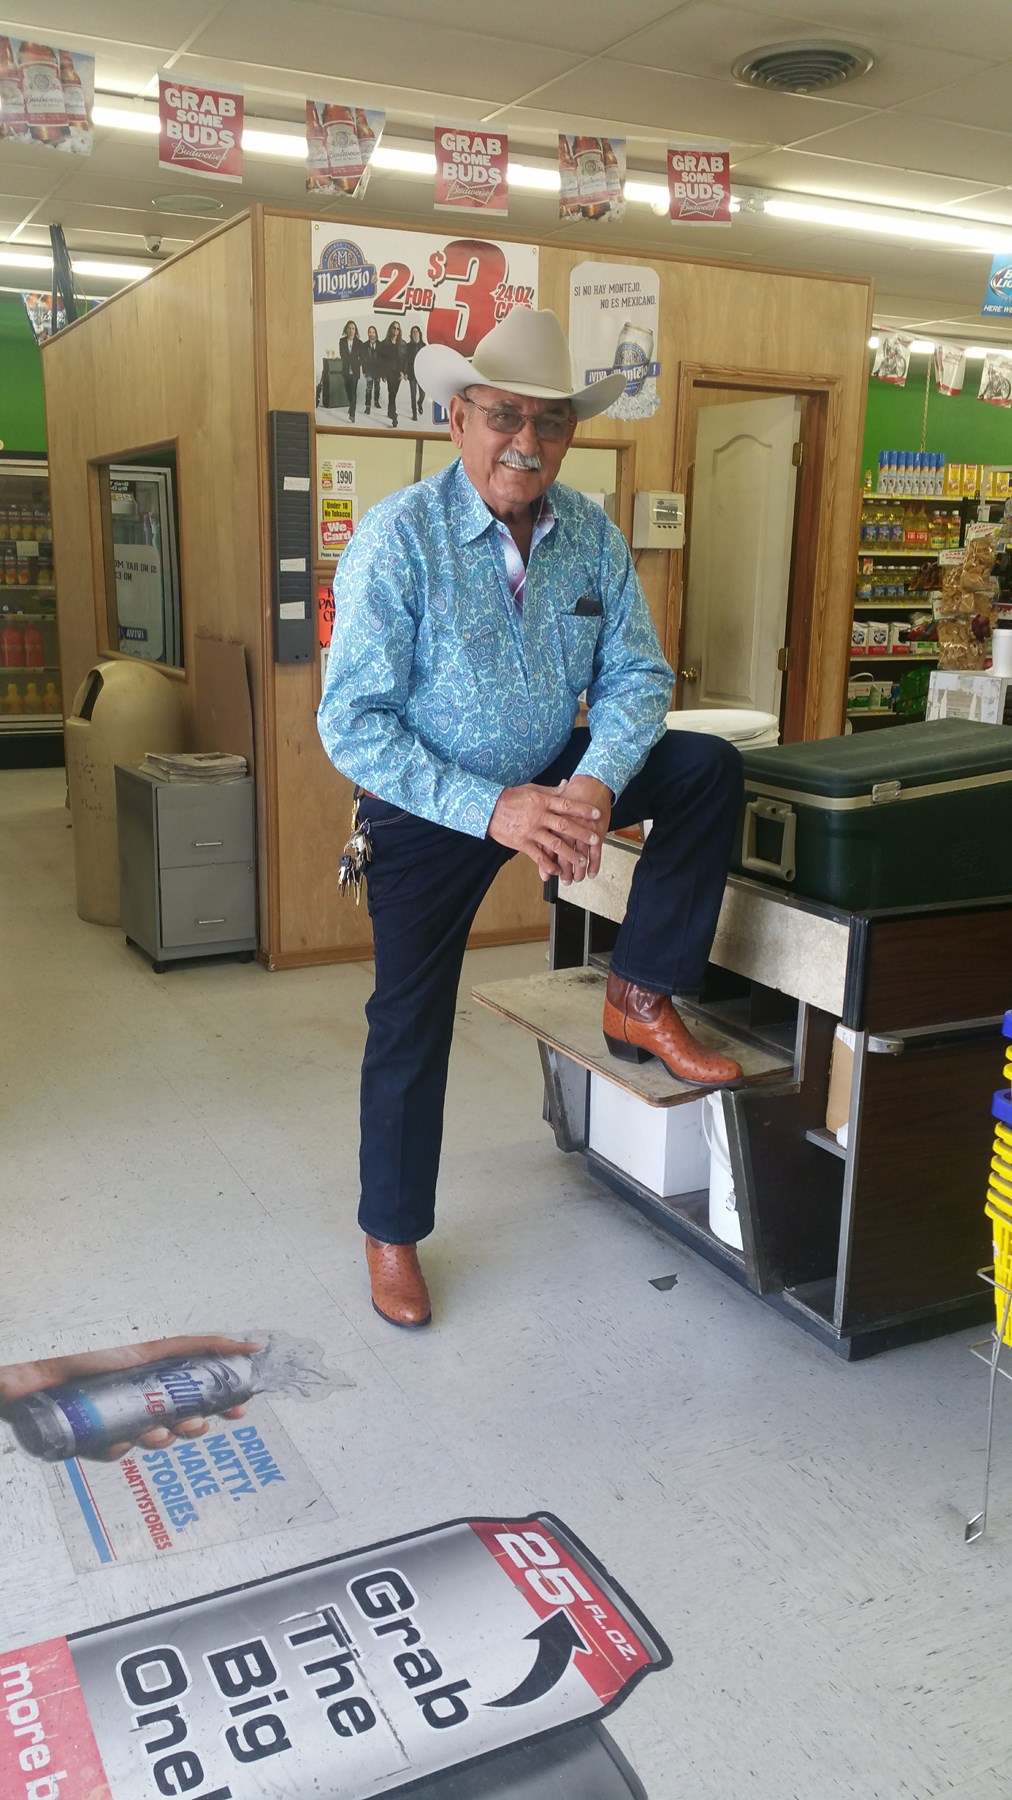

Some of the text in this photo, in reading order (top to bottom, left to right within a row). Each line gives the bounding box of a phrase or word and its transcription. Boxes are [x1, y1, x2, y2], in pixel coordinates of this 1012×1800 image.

[164, 87, 236, 117] GRAB
[176, 109, 223, 128] SOME
[166, 119, 235, 149] BUDS
[441, 132, 502, 155] GRAB
[173, 143, 226, 161] Budweiser
[452, 152, 491, 166] SOME
[672, 154, 724, 172] GRAB
[442, 162, 502, 185] BUDS
[681, 172, 715, 183] SOME
[449, 183, 495, 197] Budweiser
[674, 182, 725, 200] BUDS
[316, 268, 370, 295] Montejo
[373, 261, 412, 312] 2
[404, 287, 434, 308] FOR
[497, 283, 514, 301] 24
[574, 286, 581, 297] SI
[582, 285, 592, 296] NO
[593, 284, 607, 295] HAY
[600, 294, 657, 309] NO ES MEXICANO.
[983, 304, 1003, 313] HERE
[336, 470, 353, 485] 1990
[326, 501, 349, 510] Under 18
[323, 530, 351, 541] Card
[327, 521, 347, 532] We
[202, 1433, 258, 1502] NATTY.
[232, 1425, 287, 1487] DRINK
[172, 1441, 221, 1499] MAKE
[142, 1450, 200, 1533] STORIES.
[119, 1458, 173, 1551] #NATTYSTORIES
[493, 1531, 594, 1606] 25
[350, 1570, 472, 1729] Grab
[288, 1606, 377, 1738] The
[206, 1638, 293, 1764] Big
[0, 1661, 51, 1773] more
